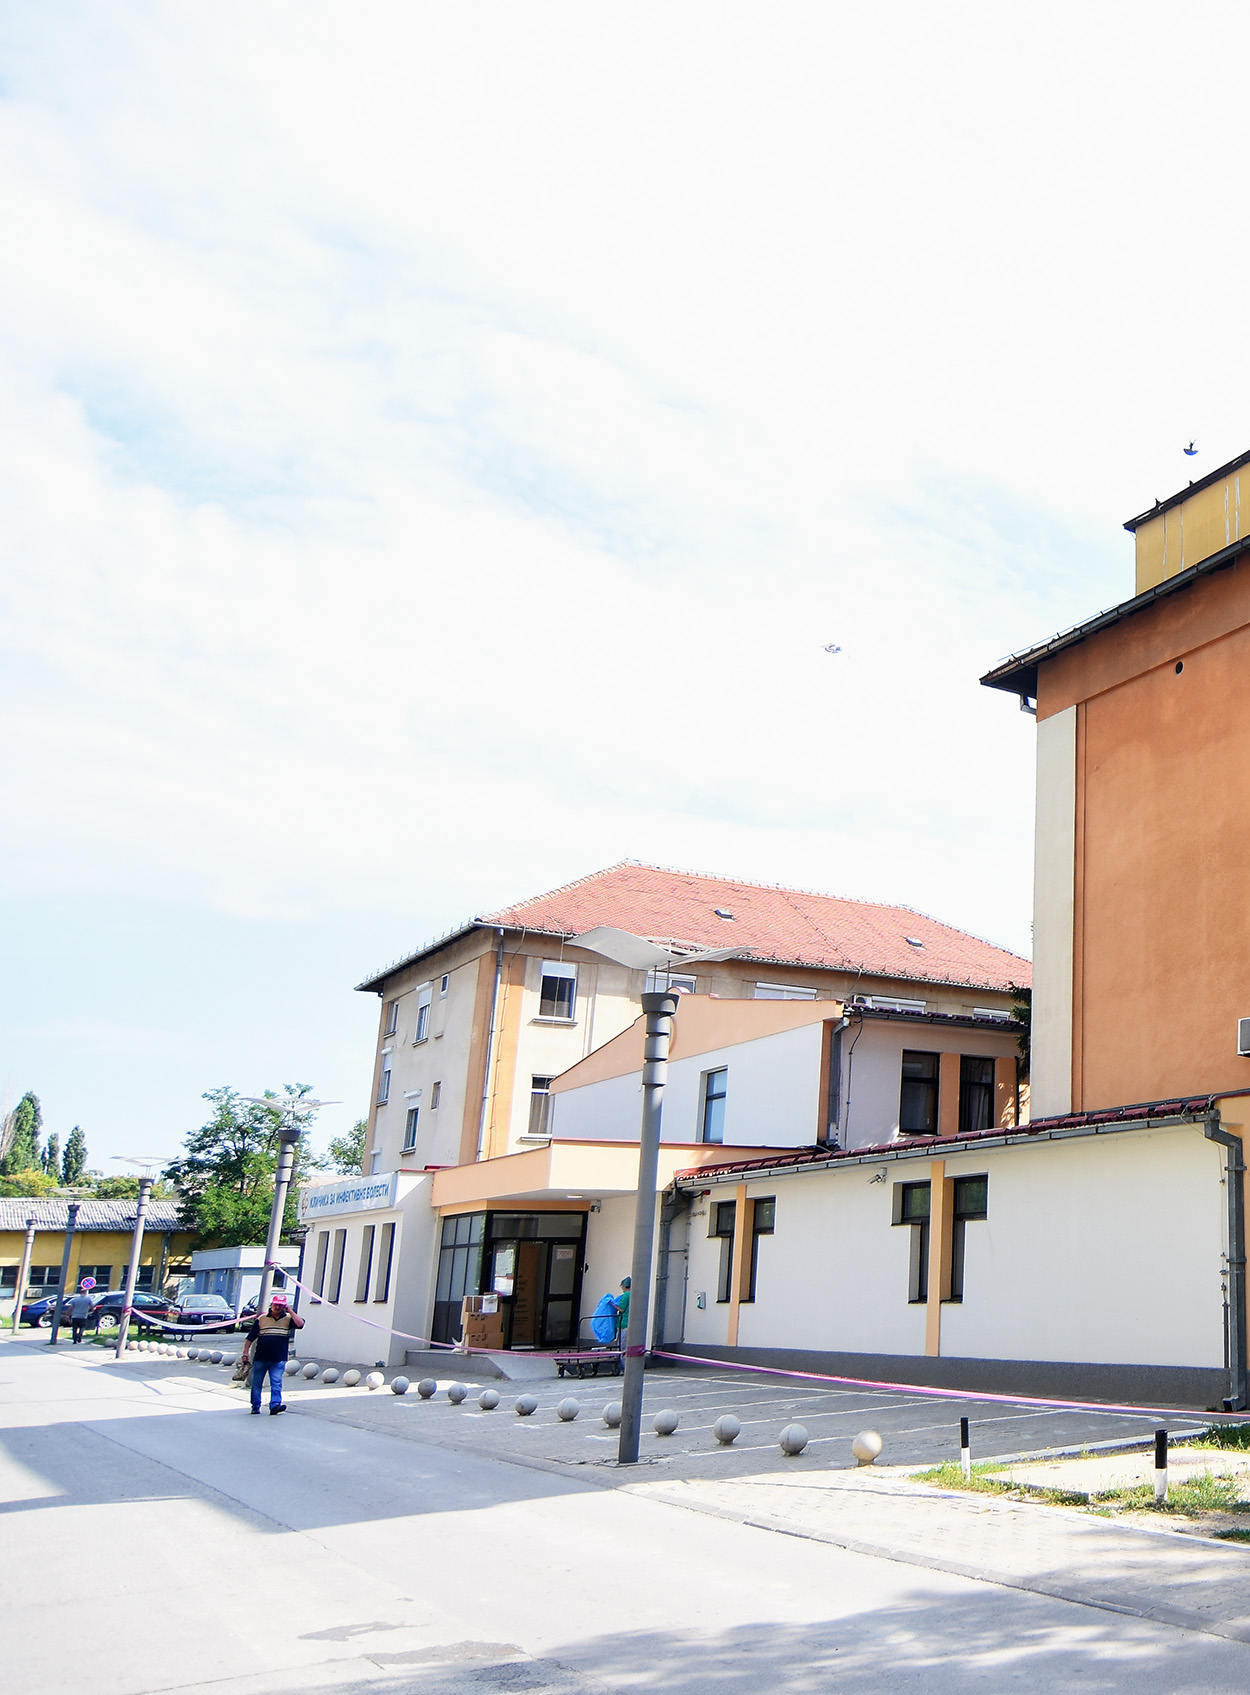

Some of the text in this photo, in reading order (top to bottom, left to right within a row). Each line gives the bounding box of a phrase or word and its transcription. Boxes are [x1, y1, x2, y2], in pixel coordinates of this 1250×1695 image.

[309, 1183, 389, 1208] КЛИНИКА ЗА ИНФЕКТИВНЕ БОЛЕСТИ
